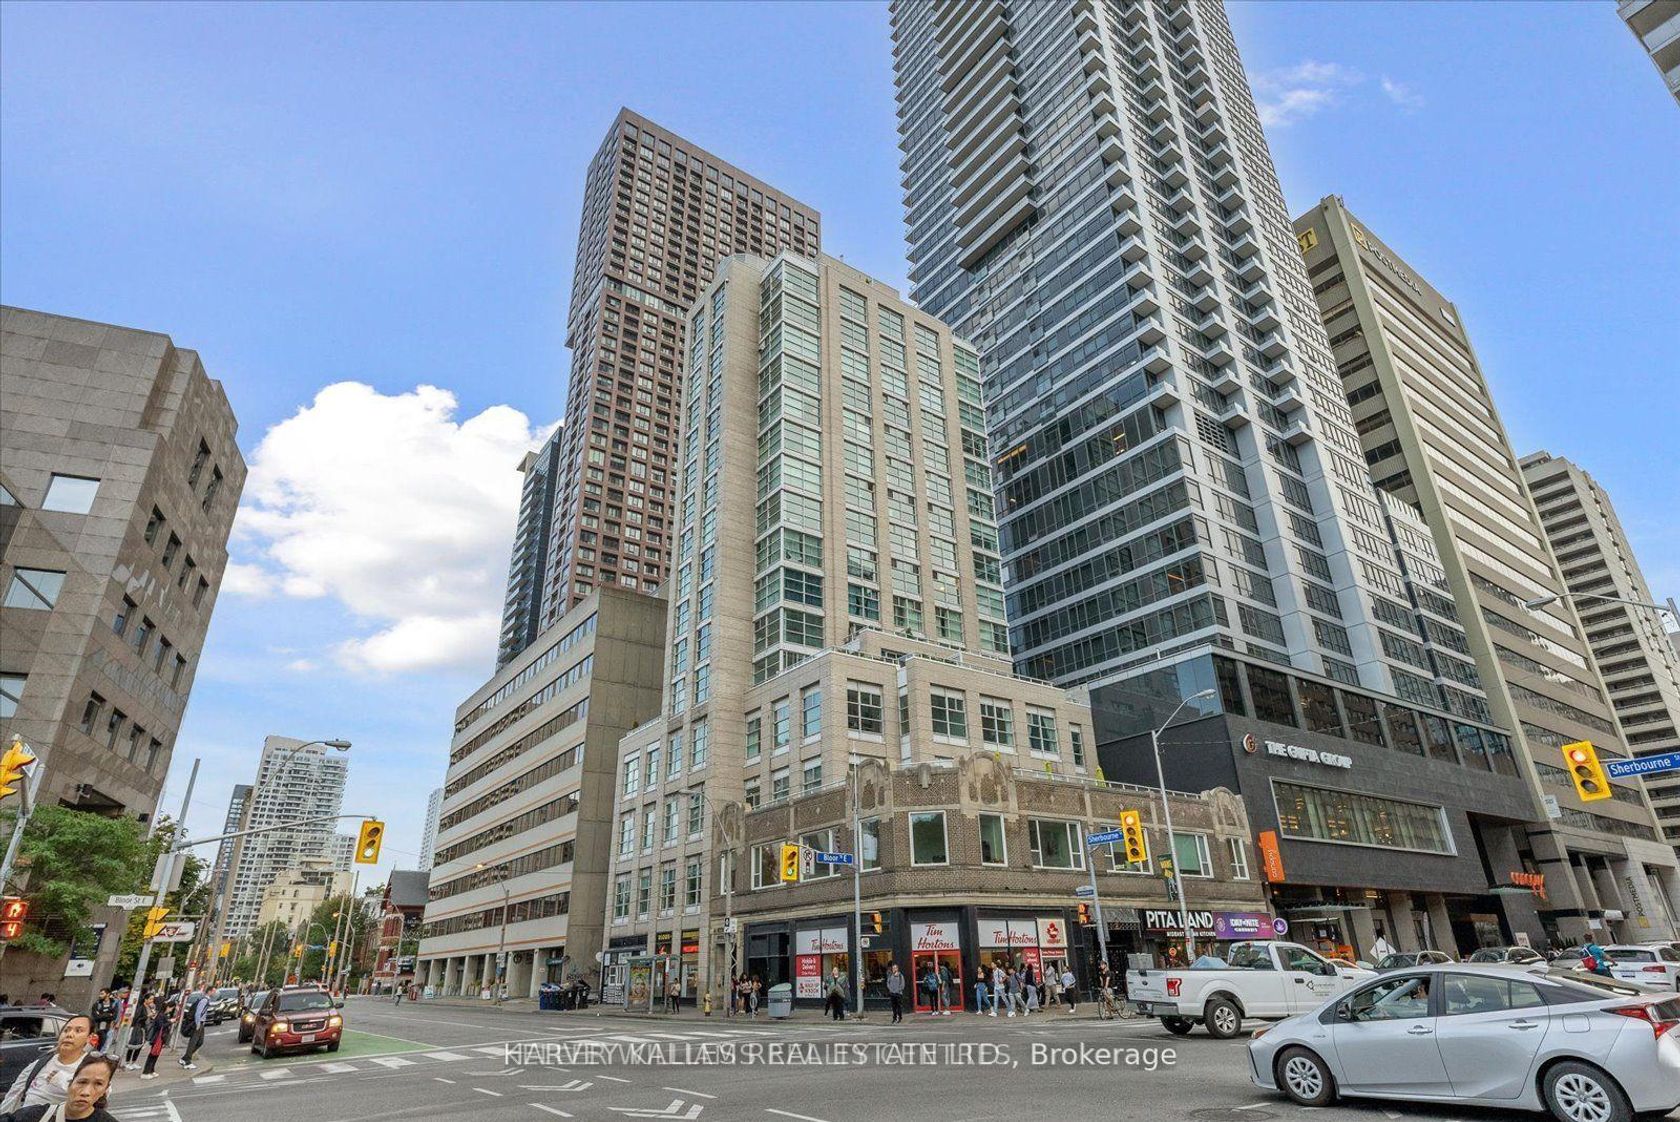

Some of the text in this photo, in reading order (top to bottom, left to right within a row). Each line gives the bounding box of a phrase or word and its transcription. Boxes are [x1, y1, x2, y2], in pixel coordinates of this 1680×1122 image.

[1610, 758, 1671, 775] Sherbourne
[1088, 832, 1119, 844] Sherbourne
[823, 853, 838, 861] Bloor
[1145, 910, 1178, 929] PITA
[1177, 911, 1214, 929] LAND
[925, 924, 943, 936] Tim
[993, 930, 1008, 944] Tim
[1008, 929, 1037, 944] Hortons
[917, 936, 954, 949] Hortons
